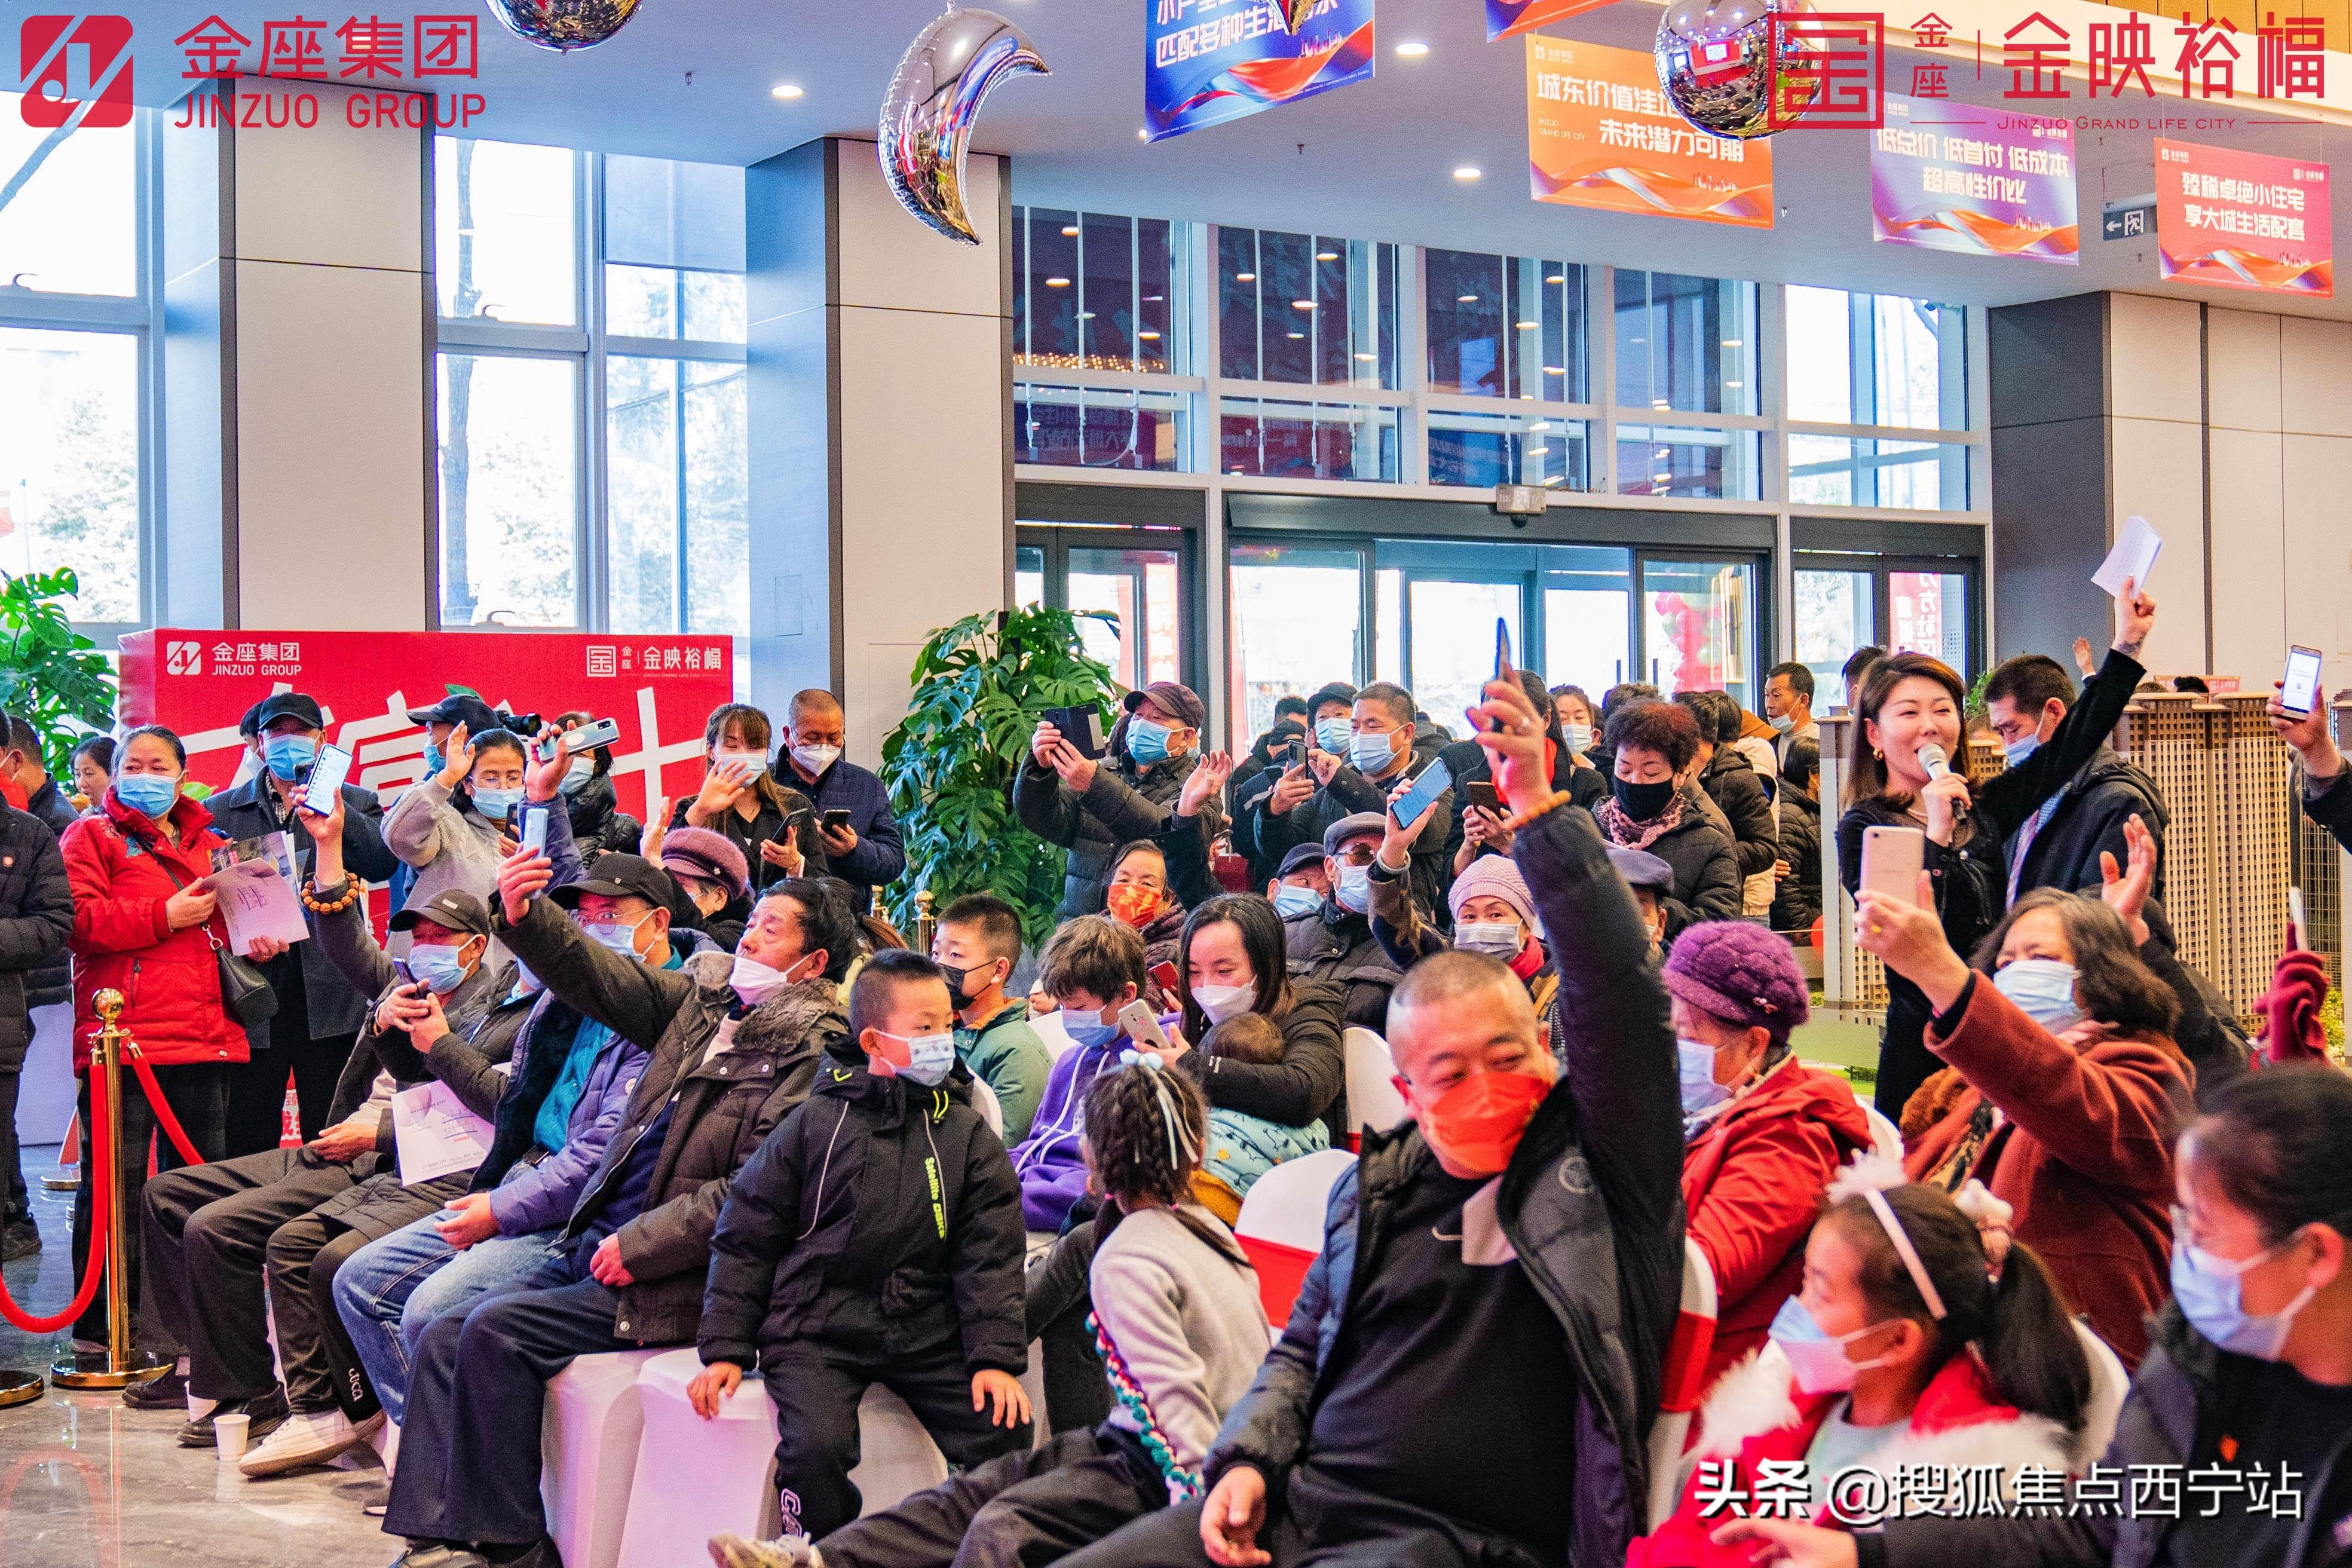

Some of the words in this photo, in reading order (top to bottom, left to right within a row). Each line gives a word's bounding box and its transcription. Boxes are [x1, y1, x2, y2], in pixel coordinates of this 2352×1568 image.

[1598, 118, 1745, 163] 未来潜力可期
[1876, 127, 1937, 160] 低总价
[1942, 136, 2004, 169] 低首付
[2008, 145, 2069, 178] 低成本
[1922, 166, 2028, 204] 超高性价比
[2182, 171, 2305, 212] 臻稀卓绝小住宅
[2184, 203, 2305, 241] 享大城生活配套
[212, 641, 300, 662] 金座集团
[212, 664, 255, 676] JINZUO
[261, 664, 302, 676] GROUP
